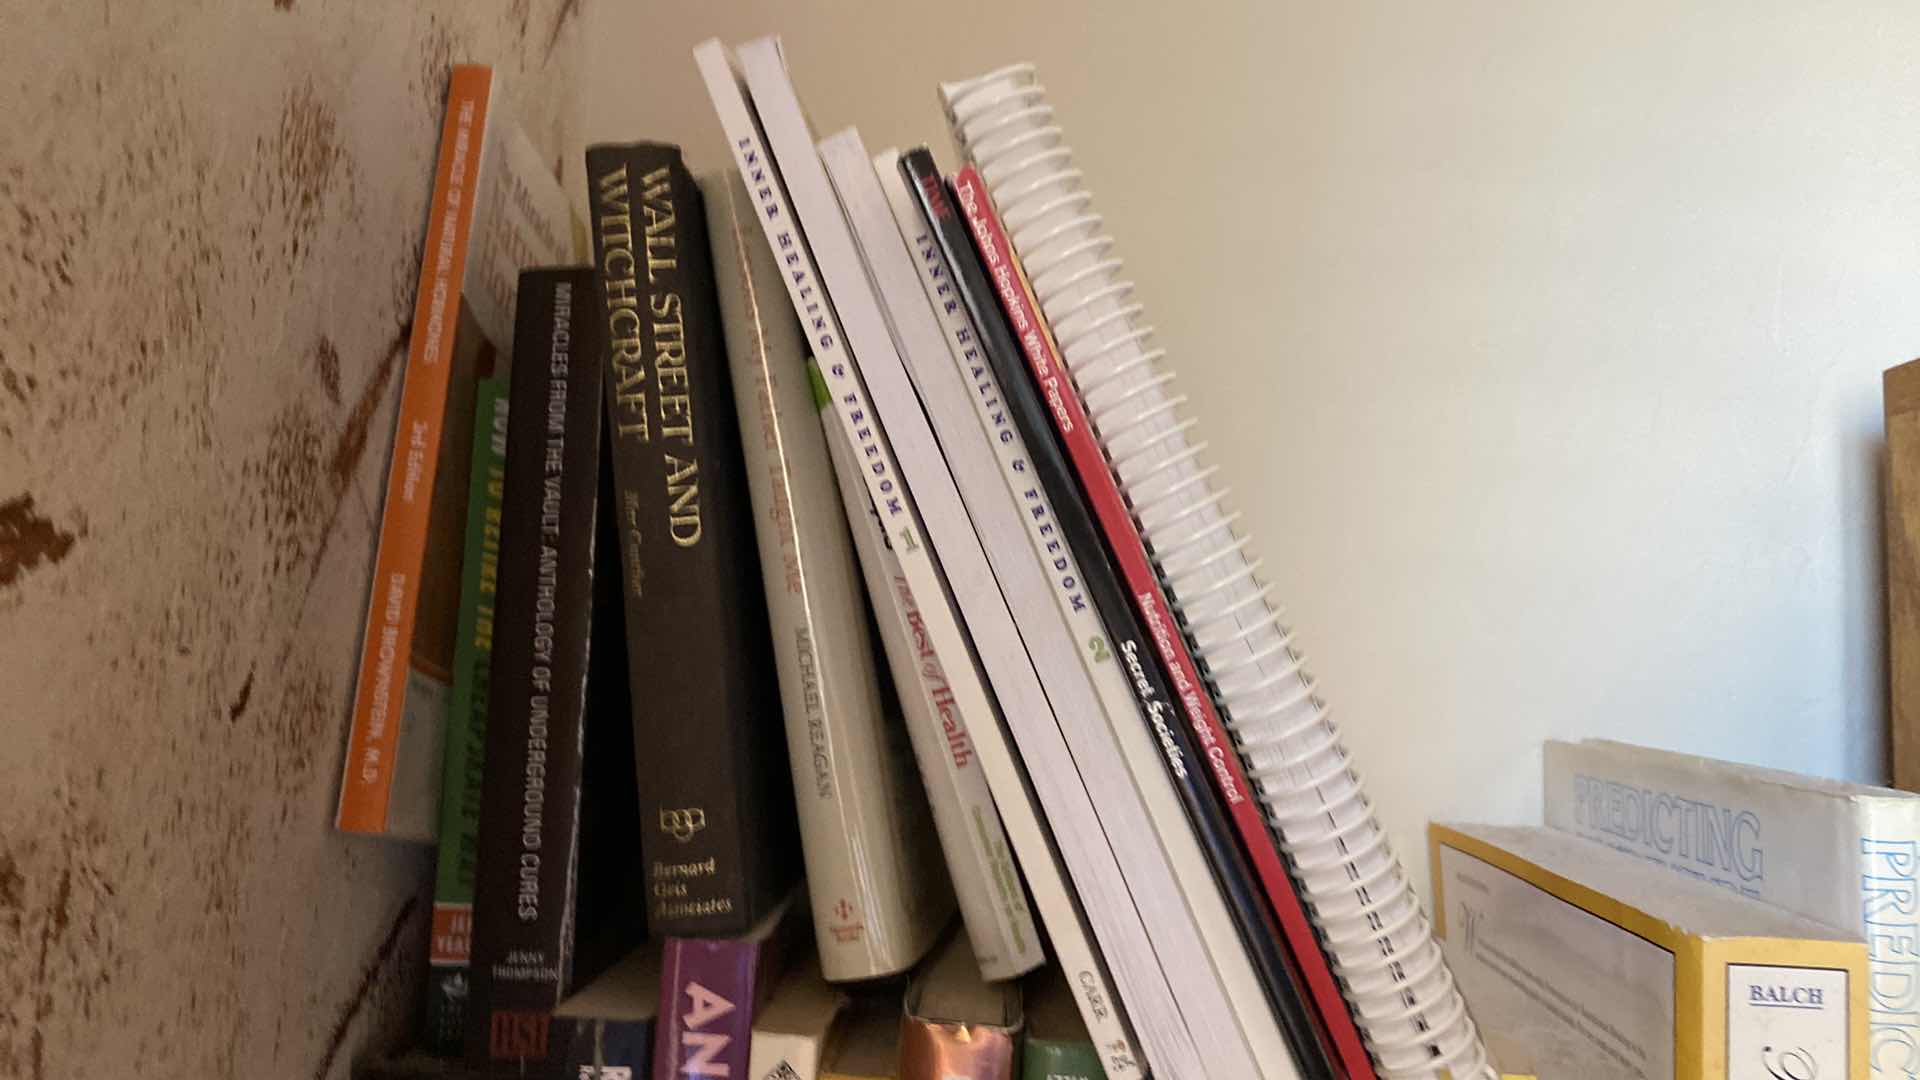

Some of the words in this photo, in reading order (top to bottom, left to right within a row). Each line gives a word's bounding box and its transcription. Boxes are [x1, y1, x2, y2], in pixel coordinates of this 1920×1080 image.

[641, 166, 678, 284] WALL
[551, 281, 572, 377] MIRACLES
[600, 162, 649, 443] WITCHCRAFT
[738, 137, 779, 220] INNER
[777, 231, 833, 349] HEALING
[844, 391, 903, 516] FREEDOM
[959, 180, 978, 214] The
[972, 212, 1001, 264] Johns
[997, 262, 1030, 330] Hopkins
[1022, 327, 1050, 377] White
[1044, 375, 1075, 433] Papers
[546, 378, 567, 432] FROM
[650, 292, 694, 446] STREET
[916, 233, 957, 316] INNER
[956, 327, 1013, 446] HEALING
[1025, 488, 1088, 614] FREEDOM
[544, 435, 564, 474] THE
[664, 453, 704, 547] AND
[534, 543, 556, 661] ANTHOLOGY
[532, 665, 550, 691] OF
[907, 609, 935, 661] Best
[933, 685, 977, 769] Health
[1119, 638, 1156, 699] Secret
[1146, 699, 1188, 780] Societies
[1138, 591, 1176, 662] Nutrition
[1169, 661, 1191, 690] and
[1182, 690, 1217, 748] Weight
[1207, 745, 1244, 805] Control
[521, 693, 549, 848] UNDERGROUND
[1572, 772, 1765, 884] PREDICTING
[518, 852, 540, 919] CURES
[1749, 984, 1825, 1005] BALCH
